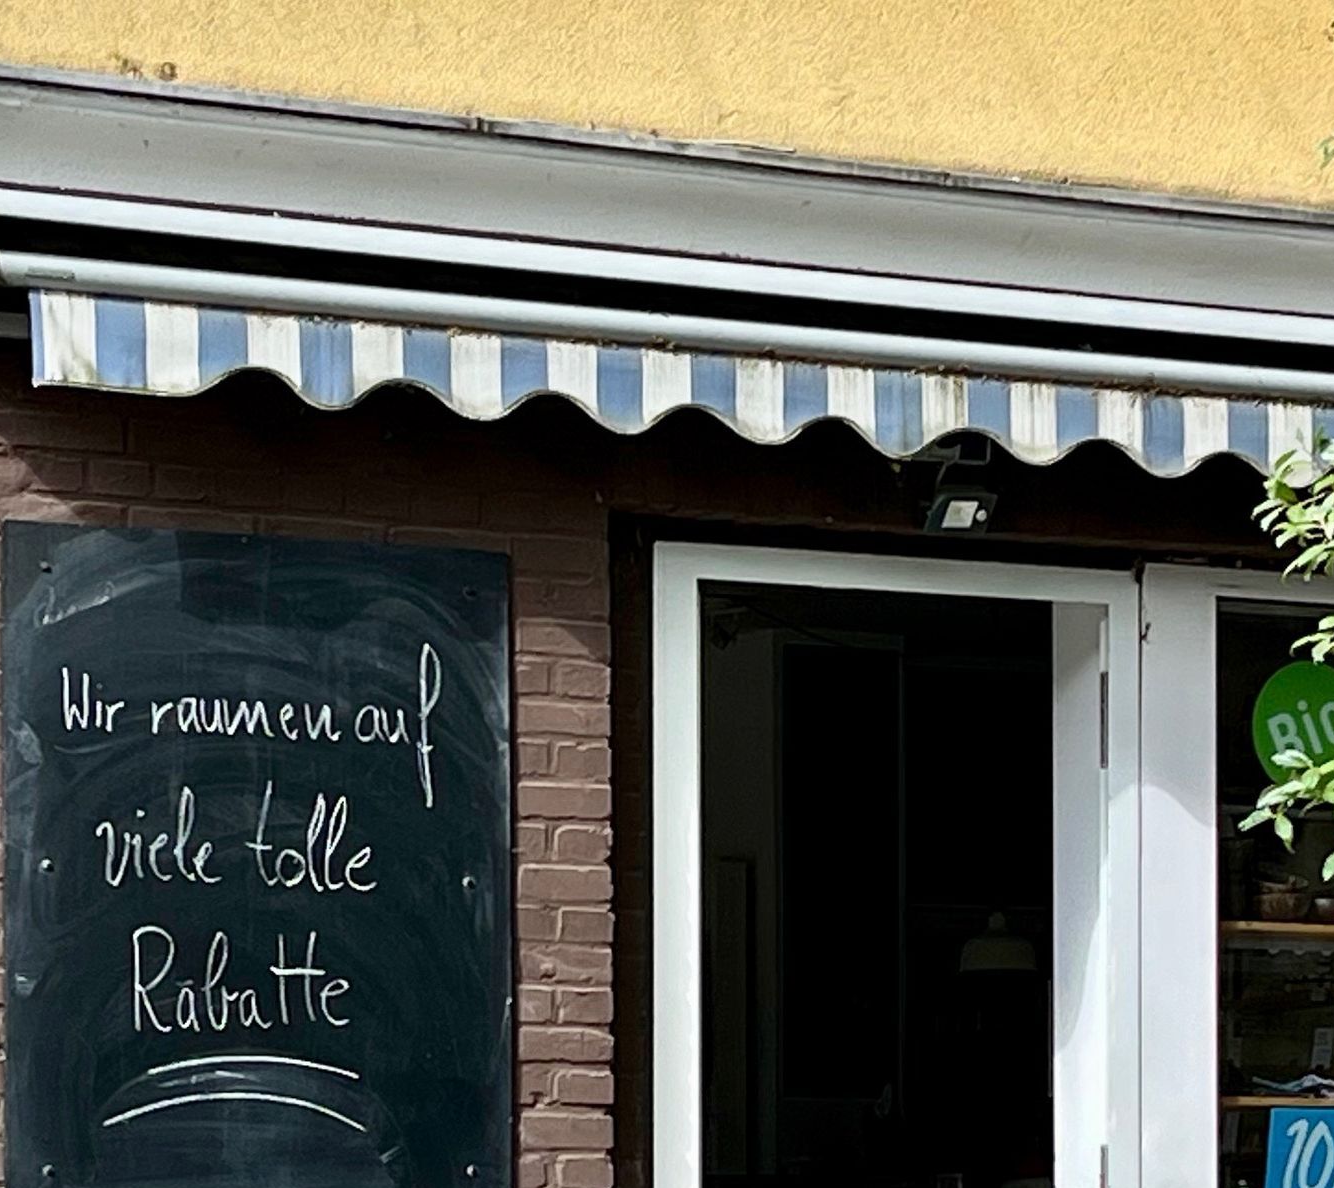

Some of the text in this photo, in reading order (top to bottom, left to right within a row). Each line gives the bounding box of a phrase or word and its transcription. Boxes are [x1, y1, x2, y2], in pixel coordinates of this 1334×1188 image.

[61, 666, 125, 733] Wir
[354, 642, 442, 808] auf
[95, 780, 377, 891] viele tolle
[132, 925, 350, 1032] Rabatte
